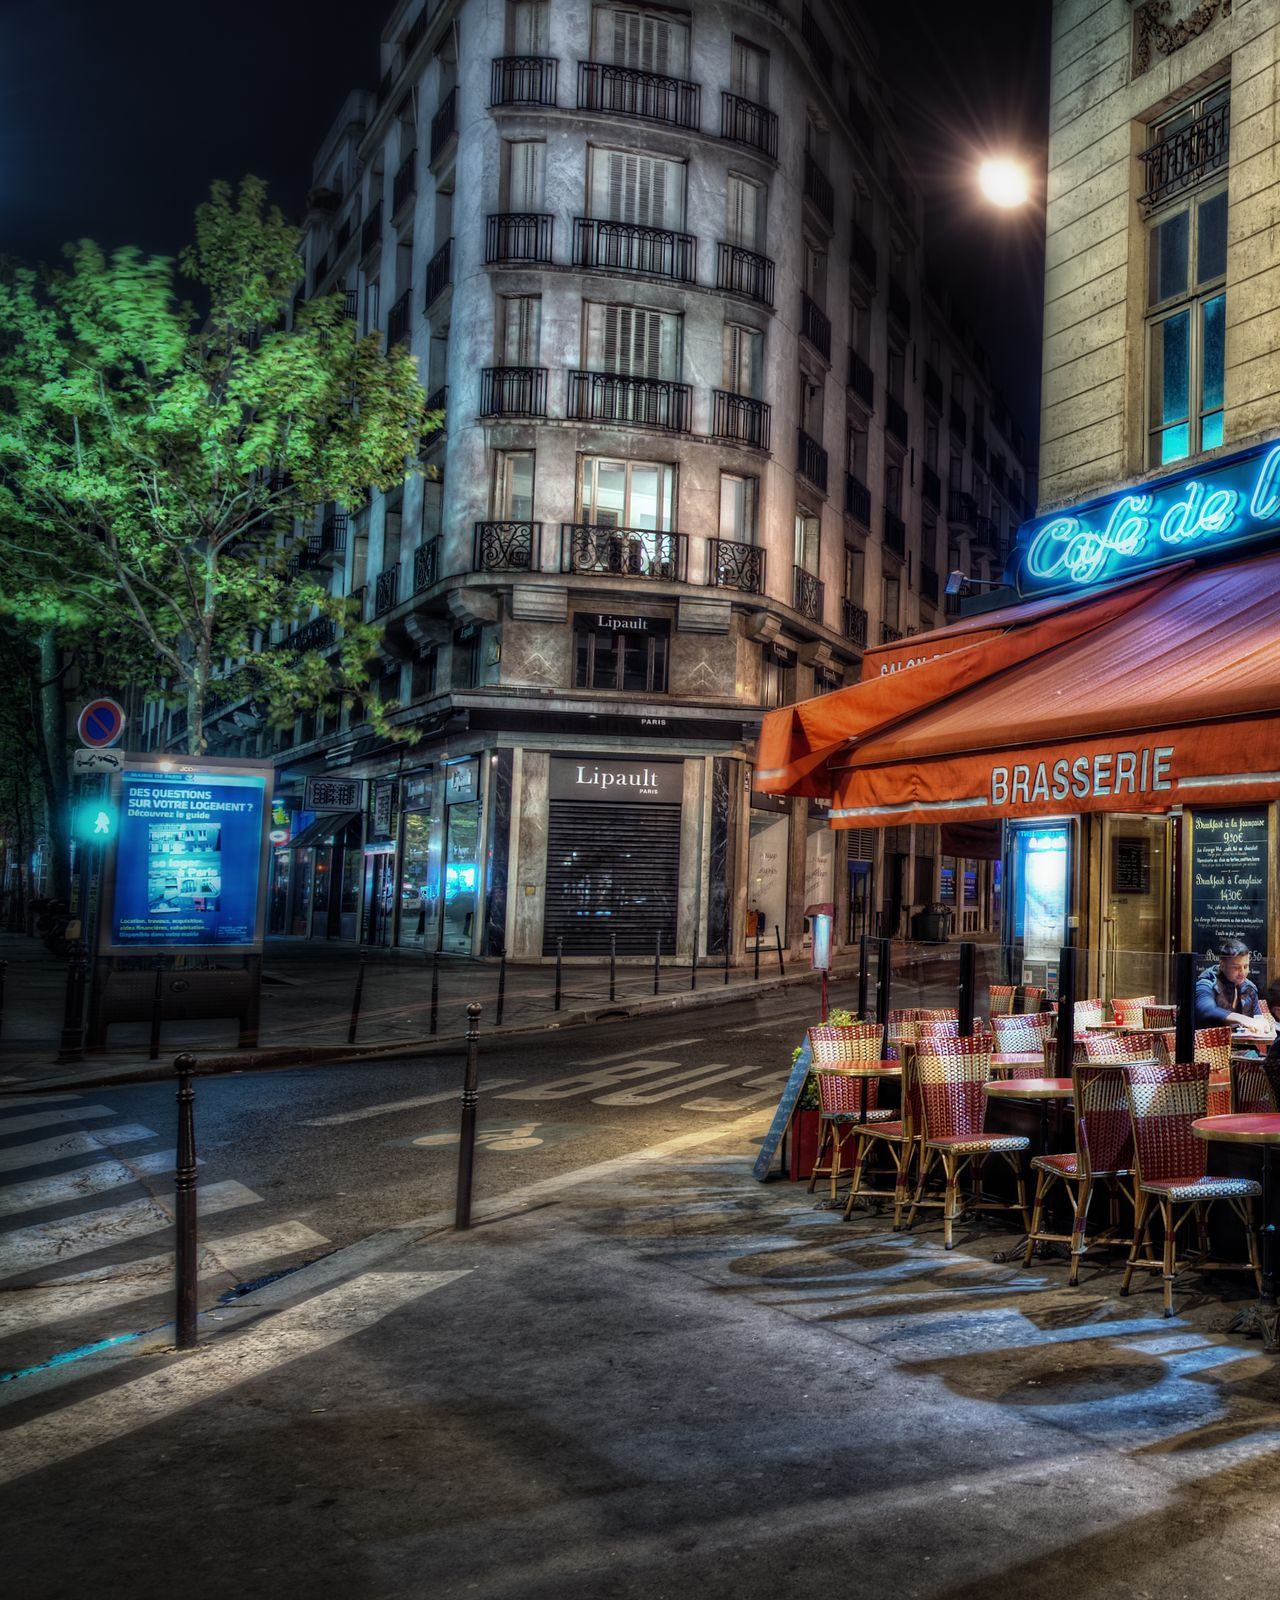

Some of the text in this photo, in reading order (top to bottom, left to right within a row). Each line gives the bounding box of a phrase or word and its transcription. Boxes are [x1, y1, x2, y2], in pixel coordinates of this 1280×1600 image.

[1027, 495, 1152, 584] Café
[1160, 481, 1240, 544] de
[598, 615, 648, 631] Lipault
[576, 766, 659, 789] Lipault
[991, 746, 1175, 806] BRASSERIE
[130, 788, 212, 800] DES QUESTIONS
[128, 798, 151, 808] SUR
[153, 800, 189, 809] VOTRE
[190, 801, 246, 812] LOGEMENT
[128, 808, 210, 820] Découvrez le guide
